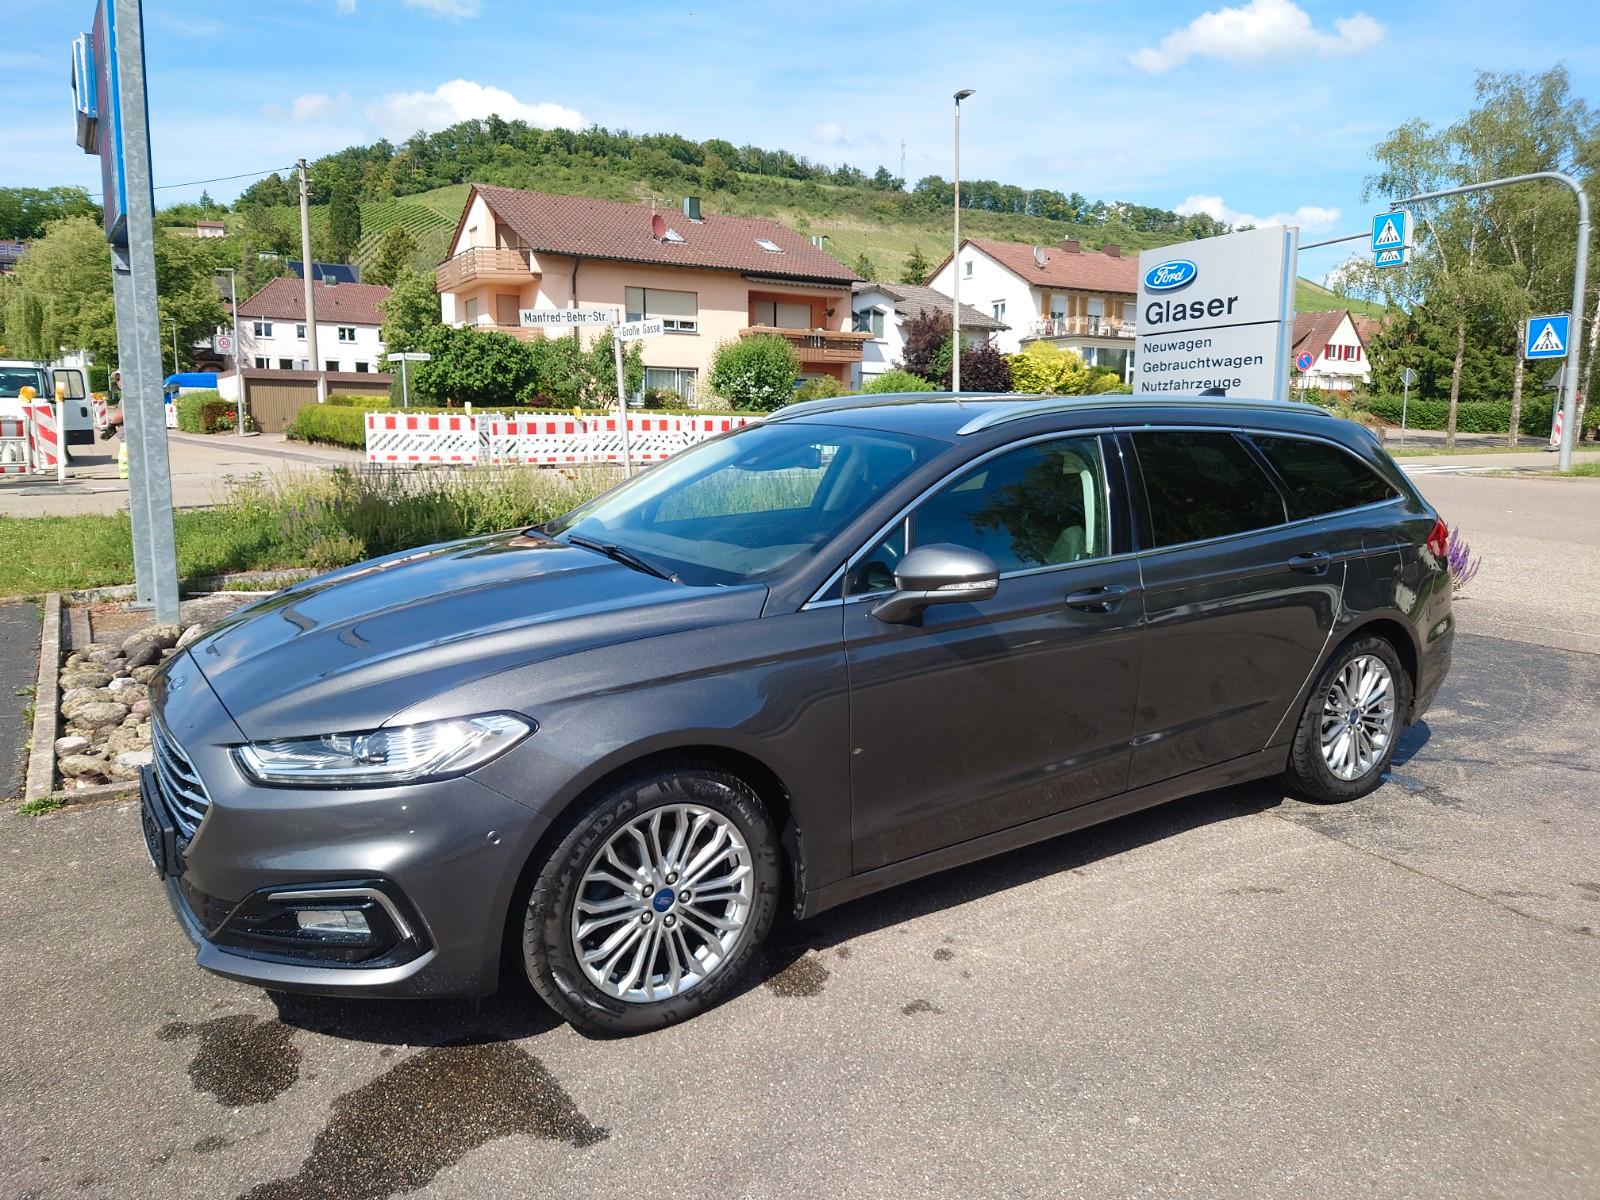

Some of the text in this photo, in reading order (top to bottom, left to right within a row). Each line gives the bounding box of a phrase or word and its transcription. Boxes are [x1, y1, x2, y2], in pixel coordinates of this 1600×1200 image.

[1153, 264, 1186, 285] Ford
[523, 311, 609, 323] Manfred-Behr-Str.
[1145, 295, 1239, 325] Glaser
[622, 323, 661, 337] Große Gasse
[1143, 338, 1212, 354] Neuwagen
[1142, 354, 1263, 373] Gebrauchtwagen
[1141, 377, 1242, 393] Nutzfahrzeuge
